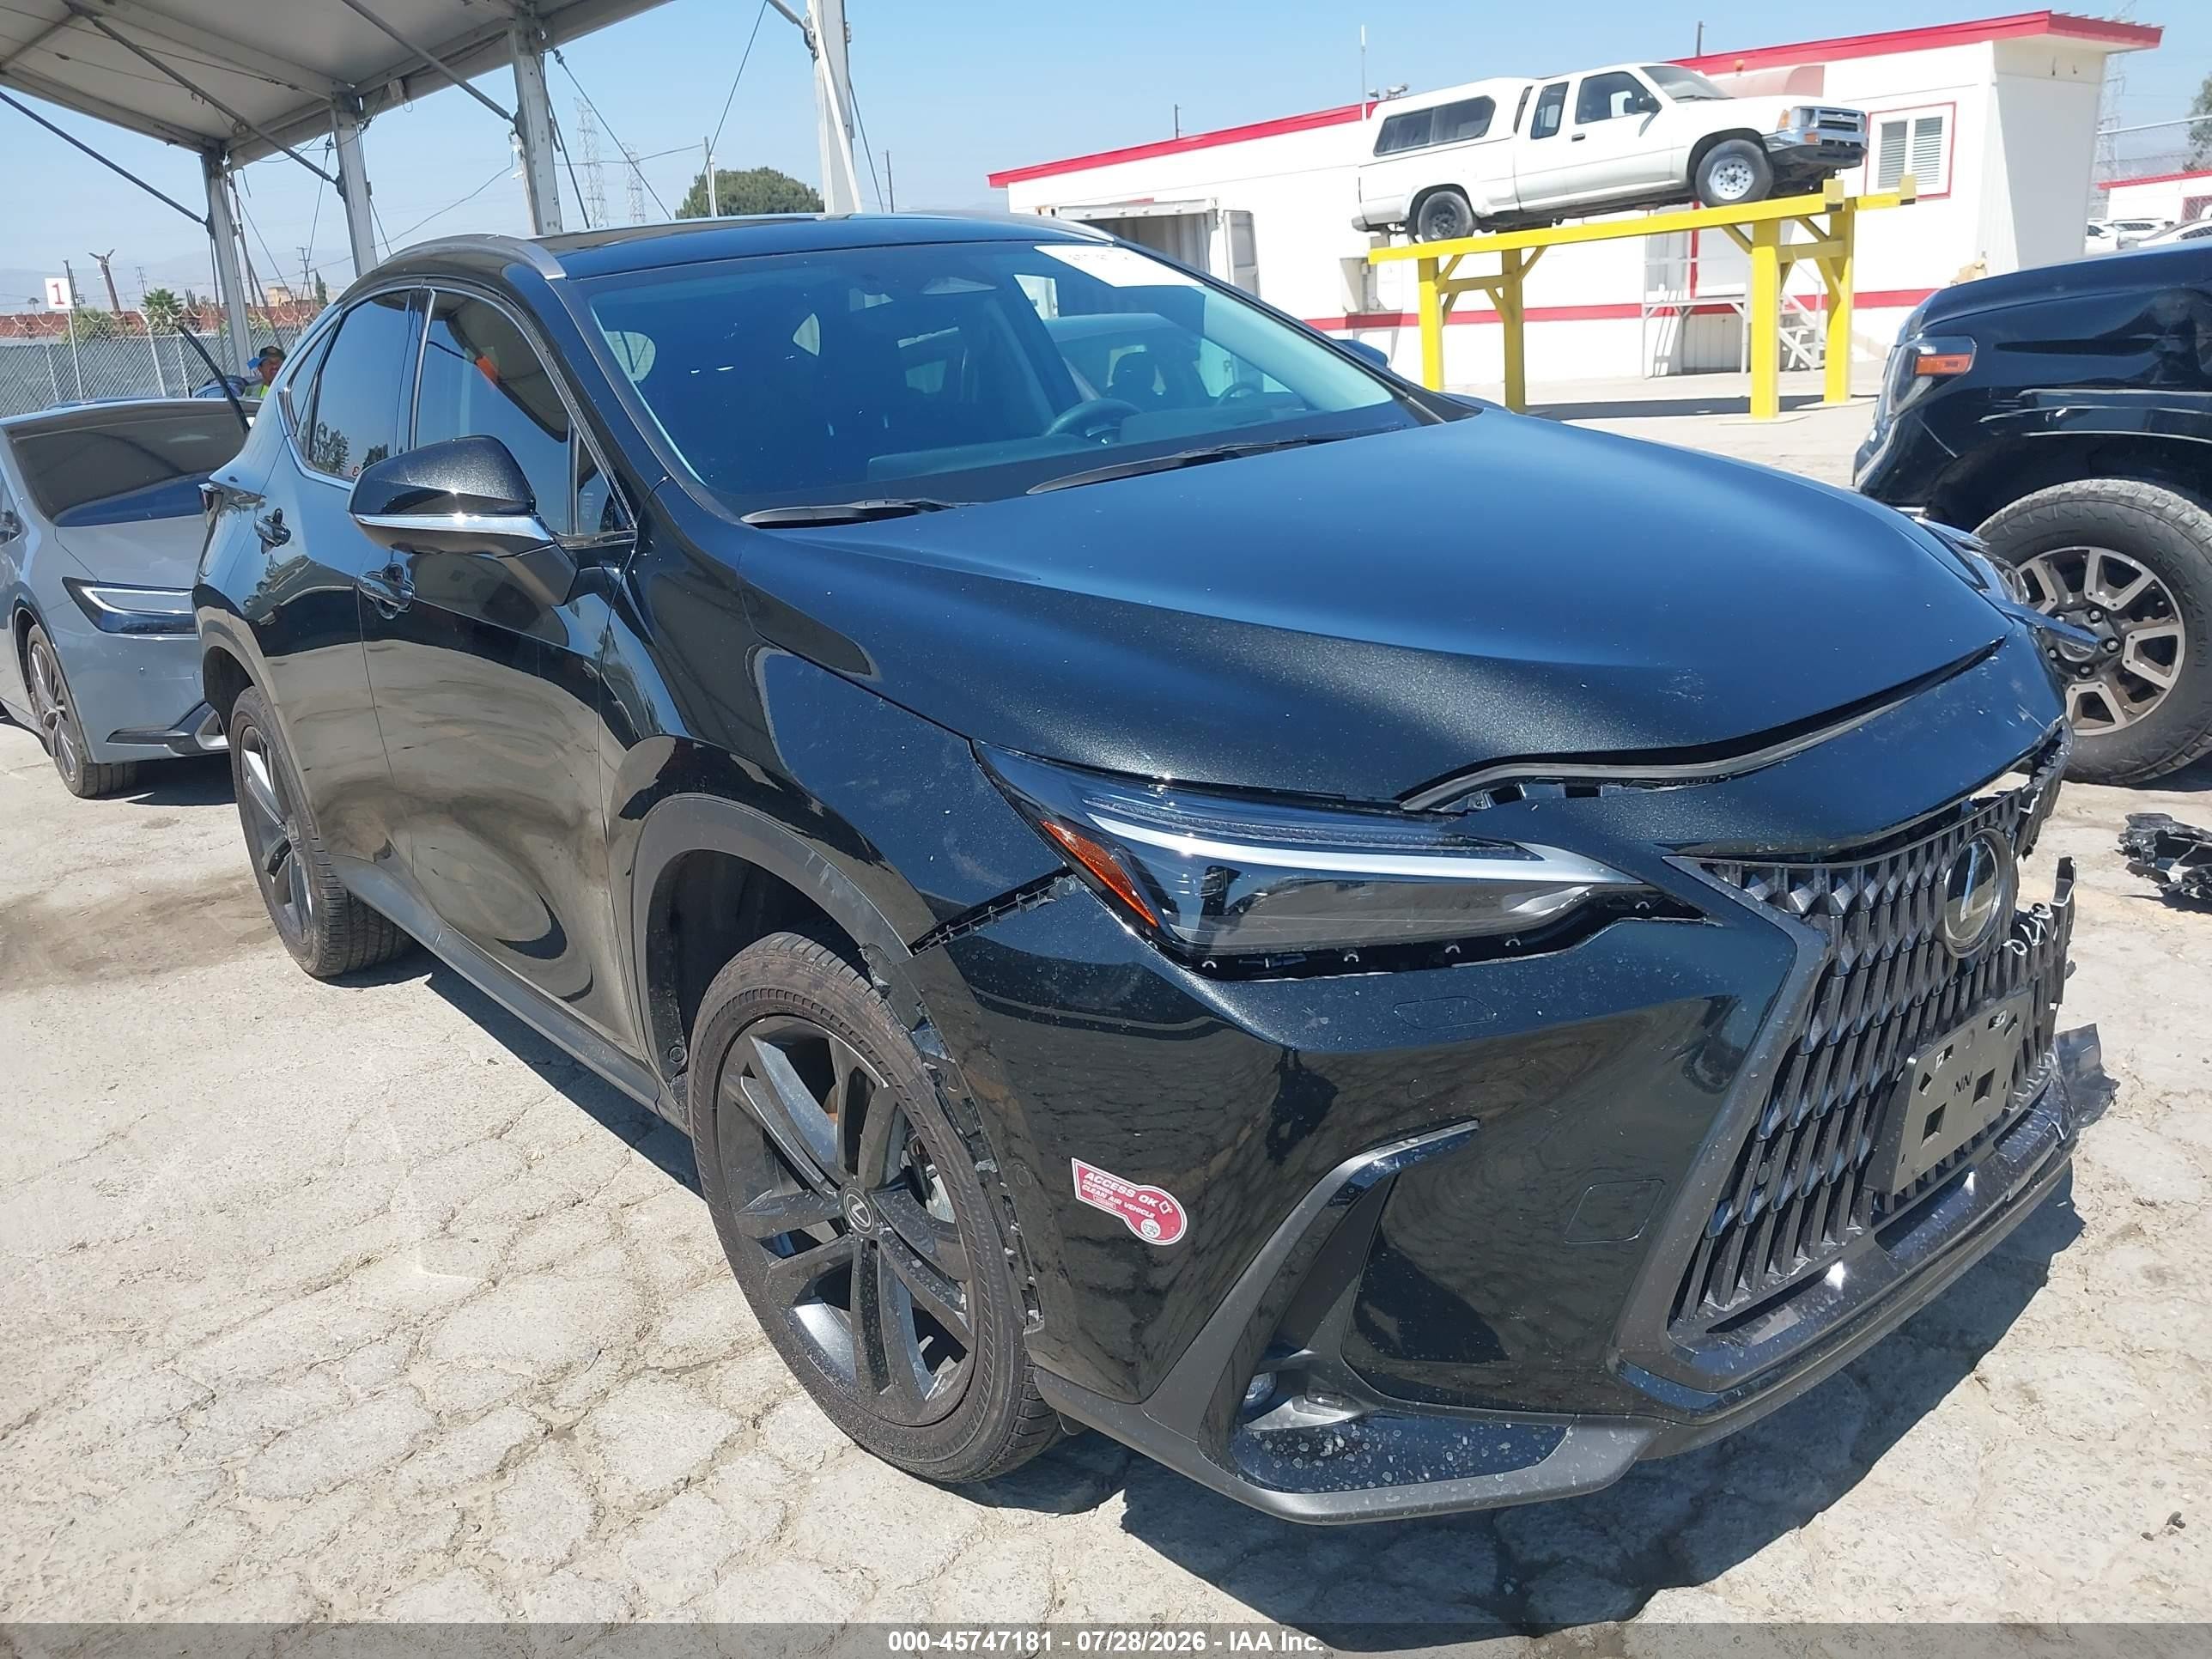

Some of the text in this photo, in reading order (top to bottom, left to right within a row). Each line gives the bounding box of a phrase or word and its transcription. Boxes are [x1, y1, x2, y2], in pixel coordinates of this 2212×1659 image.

[52, 282, 65, 305] 1
[1081, 1184, 1108, 1199] CLEAN
[1108, 1195, 1122, 1206] AIR
[1124, 1201, 1156, 1218] VEHICLE
[1084, 1172, 1136, 1198] ACCESS
[1138, 1194, 1159, 1207] OK
